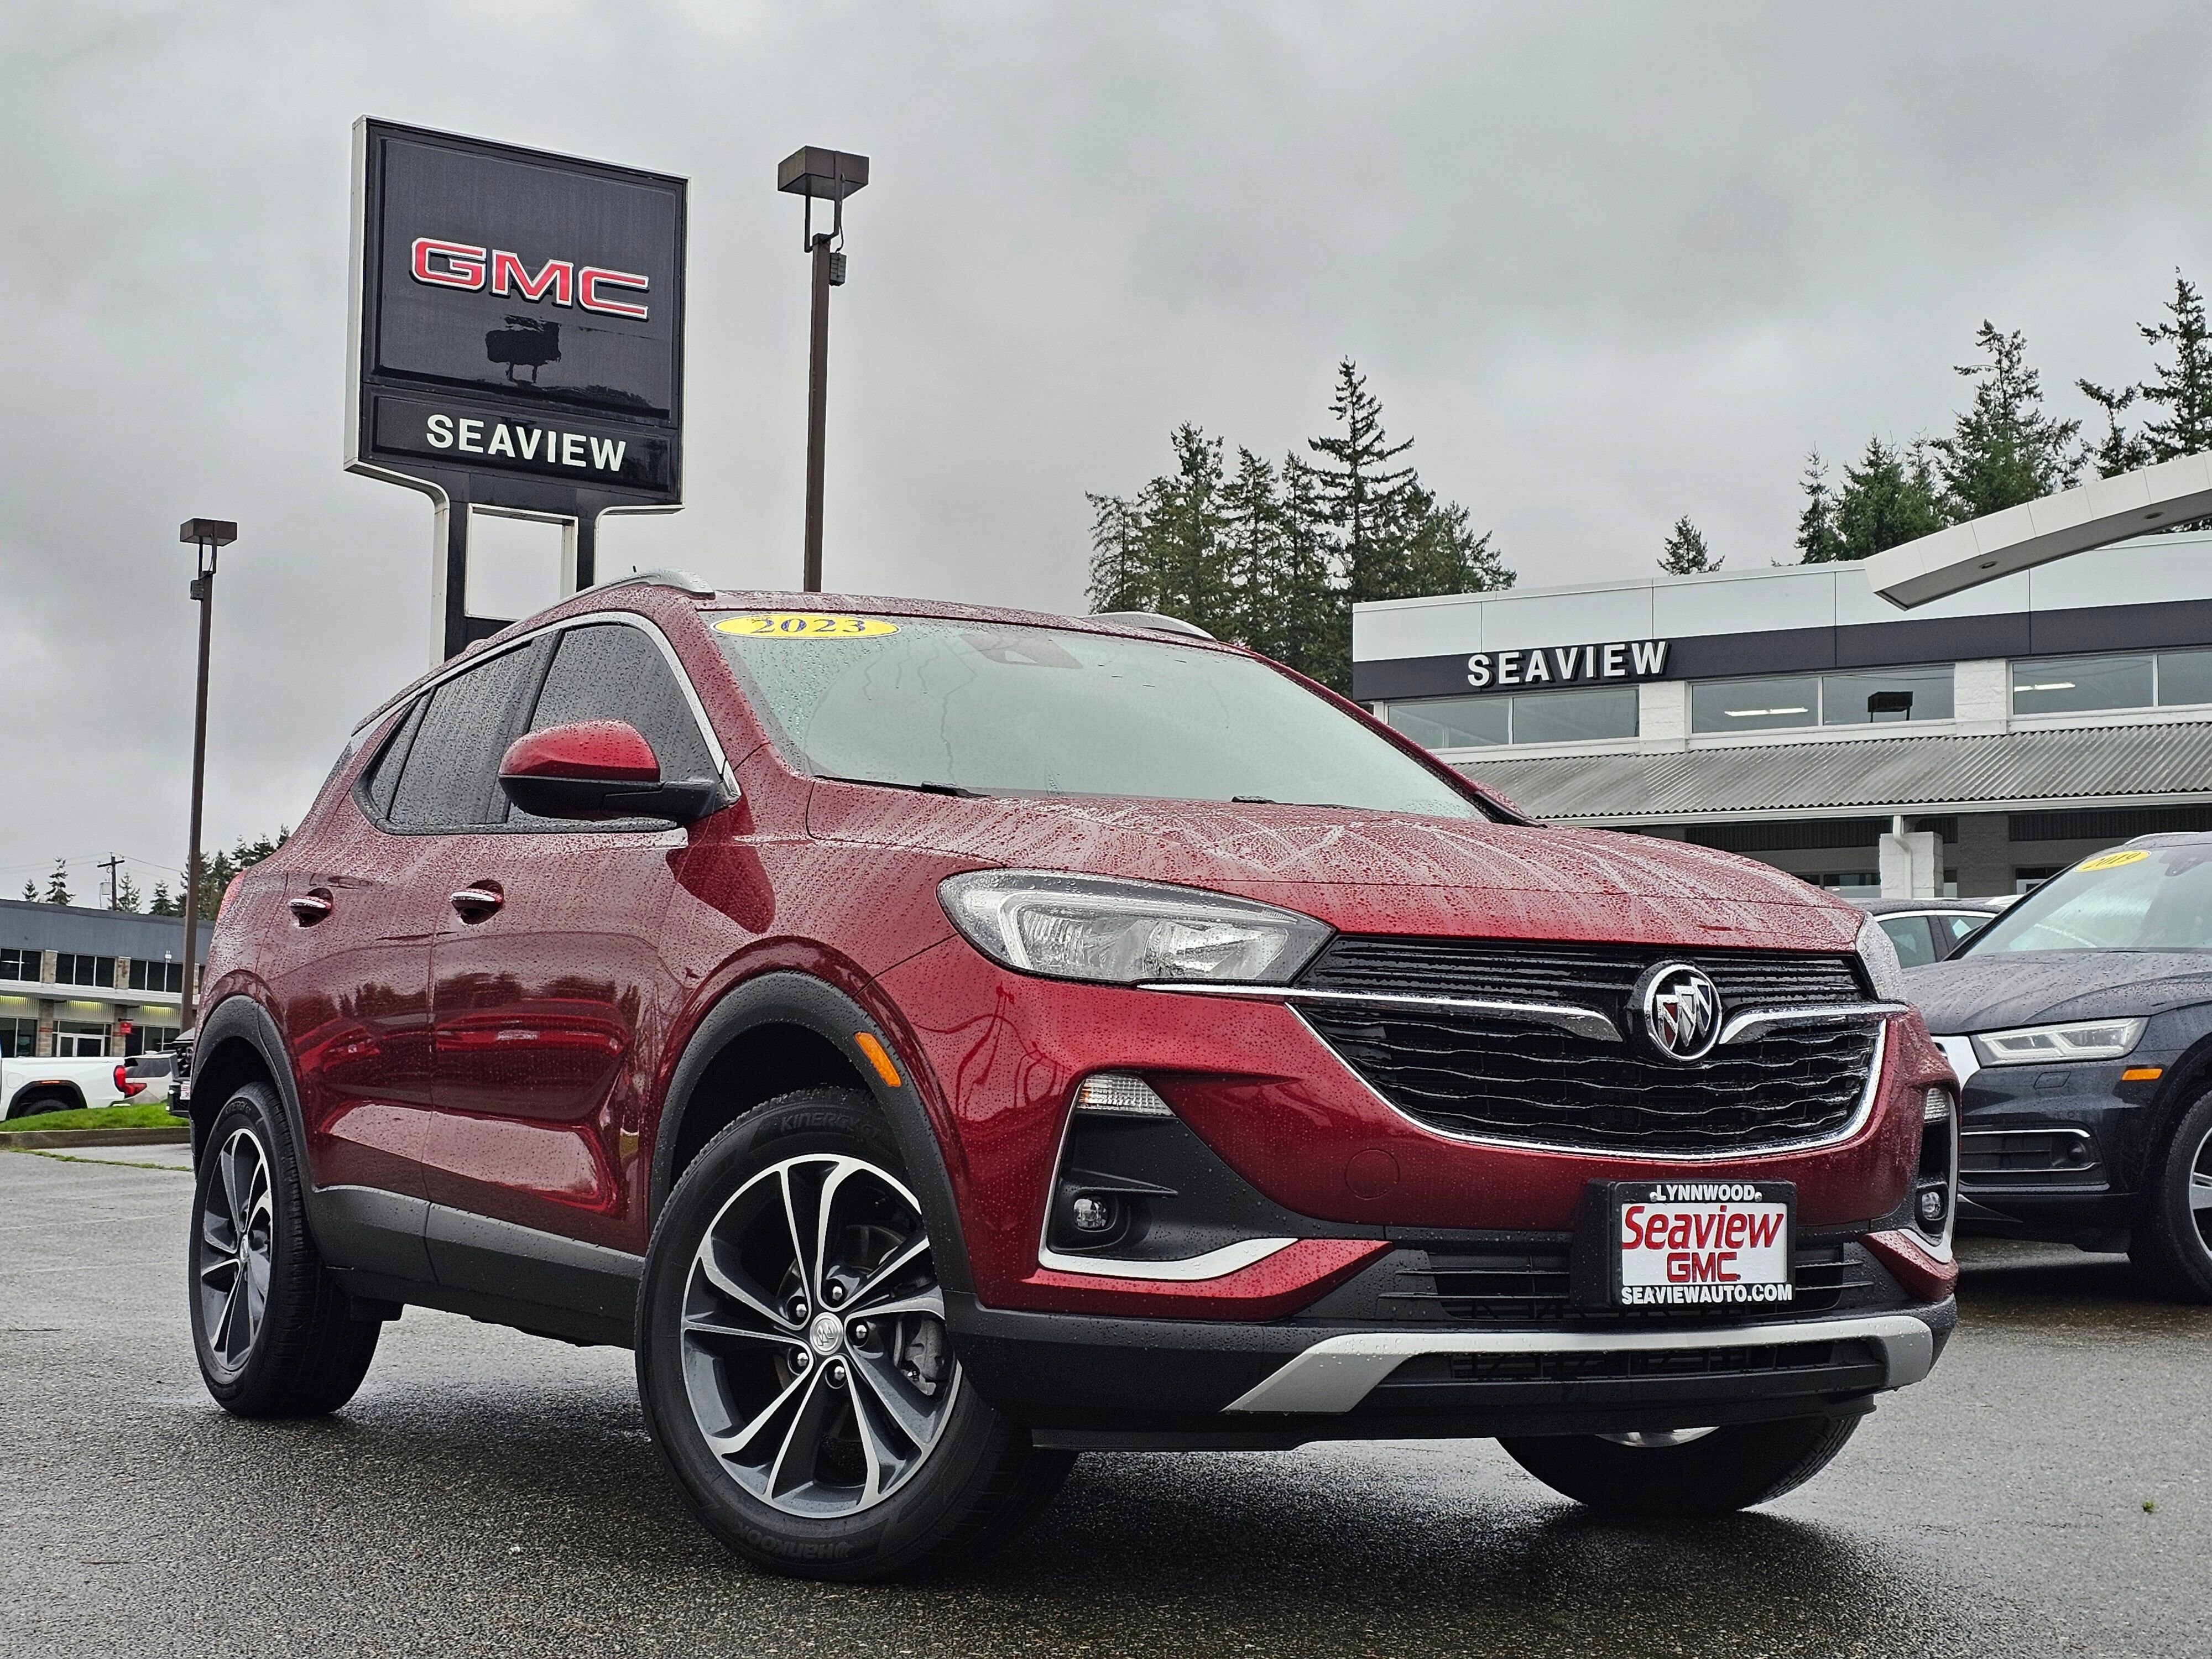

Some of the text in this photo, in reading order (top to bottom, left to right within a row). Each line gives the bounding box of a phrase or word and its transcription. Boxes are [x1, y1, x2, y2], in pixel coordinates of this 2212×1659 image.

[411, 237, 649, 319] GMC
[426, 414, 626, 472] SEAVIEW
[750, 618, 867, 634] 2023
[1467, 641, 1667, 687] SEAVIEW
[1656, 1185, 1755, 1202] LYNNWOOD
[1622, 1205, 1785, 1250] Seaview
[1667, 1252, 1739, 1282] GMC
[1621, 1285, 1792, 1305] SEAVIEWAUTO.COM
